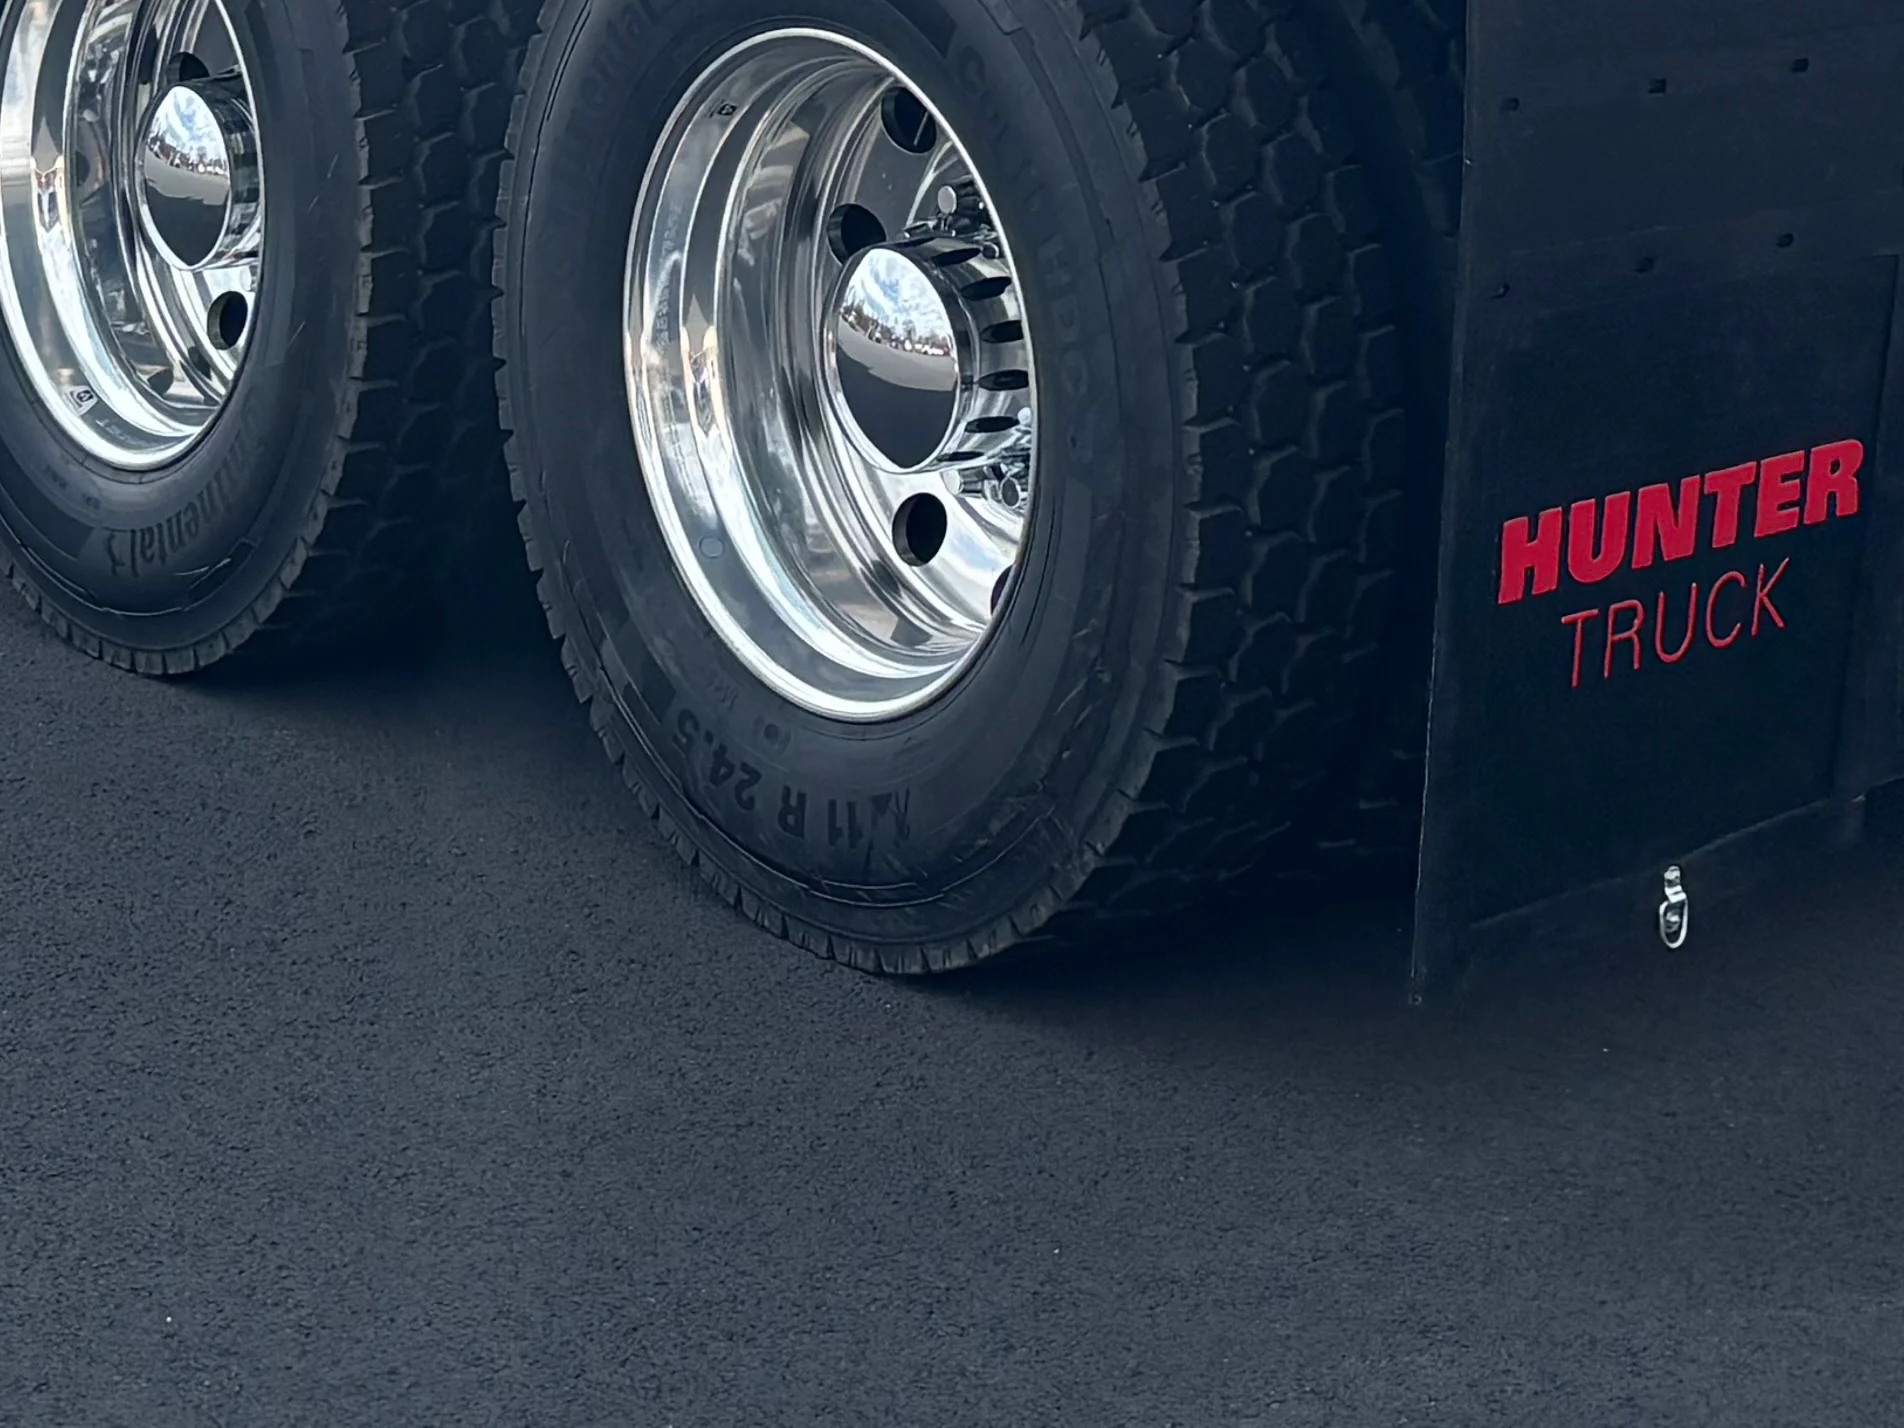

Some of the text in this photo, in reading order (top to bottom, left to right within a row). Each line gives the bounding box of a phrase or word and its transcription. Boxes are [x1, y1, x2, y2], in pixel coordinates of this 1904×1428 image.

[1497, 438, 1866, 605] HUNTER
[1560, 556, 1792, 688] TRUCK
[670, 708, 764, 812] 24.5
[777, 783, 808, 840] R
